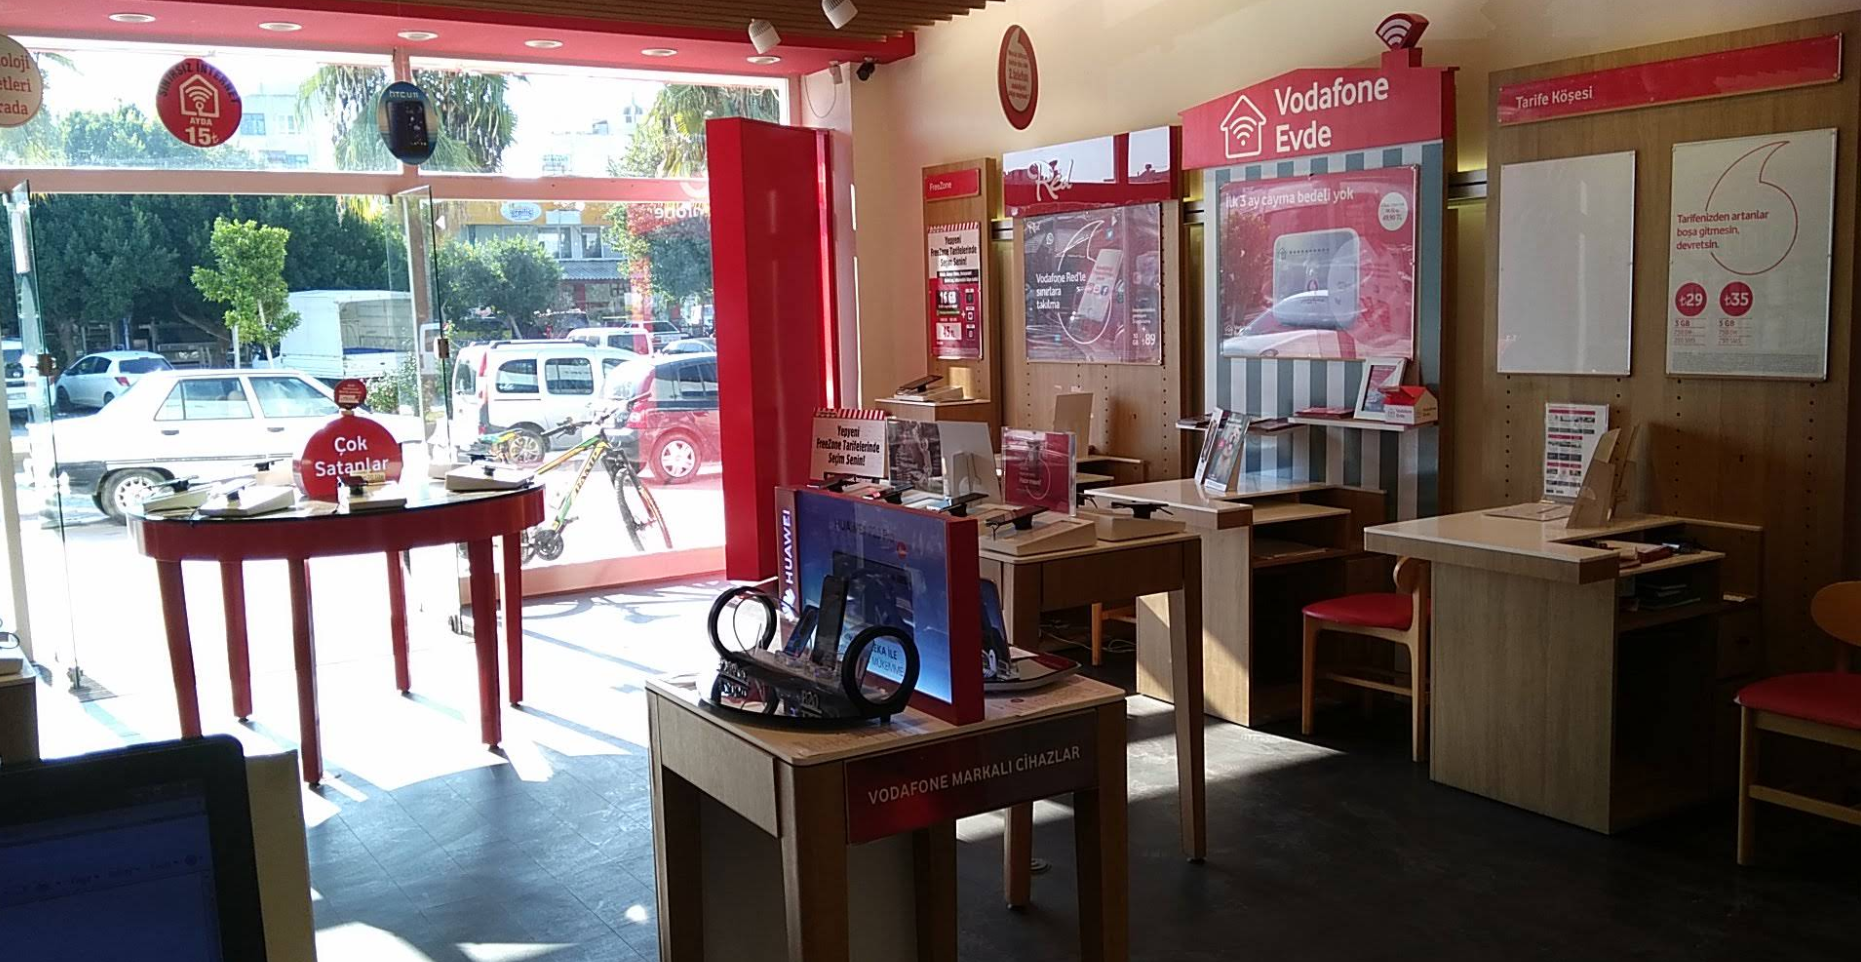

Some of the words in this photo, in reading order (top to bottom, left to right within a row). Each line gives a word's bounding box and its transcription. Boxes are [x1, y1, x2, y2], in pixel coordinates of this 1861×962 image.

[1274, 77, 1389, 116] Vodafone
[1515, 93, 1549, 110] Tarife
[1551, 85, 1593, 105] Köşesi
[1276, 120, 1332, 153] Evde
[1248, 195, 1261, 209] ay
[1262, 192, 1295, 208] cayma
[1297, 188, 1330, 202] bedeli
[1333, 187, 1354, 204] yok
[1677, 212, 1730, 224] Tarifenizden
[1731, 209, 1770, 221] artanlar
[1676, 227, 1697, 238] boşa
[1035, 272, 1065, 284] Vodafone
[1036, 287, 1062, 297] sınırlara
[1036, 299, 1060, 310] takılma
[837, 425, 860, 440] Yepyeni
[334, 435, 368, 457] Çok
[816, 437, 842, 450] FreeZone
[843, 440, 880, 453] Tarifelerinde
[315, 457, 389, 477] Satanlar
[828, 452, 845, 466] Seçim
[846, 454, 866, 466] Senin!
[782, 509, 794, 584] HUAWEI
[867, 774, 949, 805] VODAFONE
[952, 760, 1013, 787] MARKALI
[1015, 745, 1081, 772] CİHAZLAR
